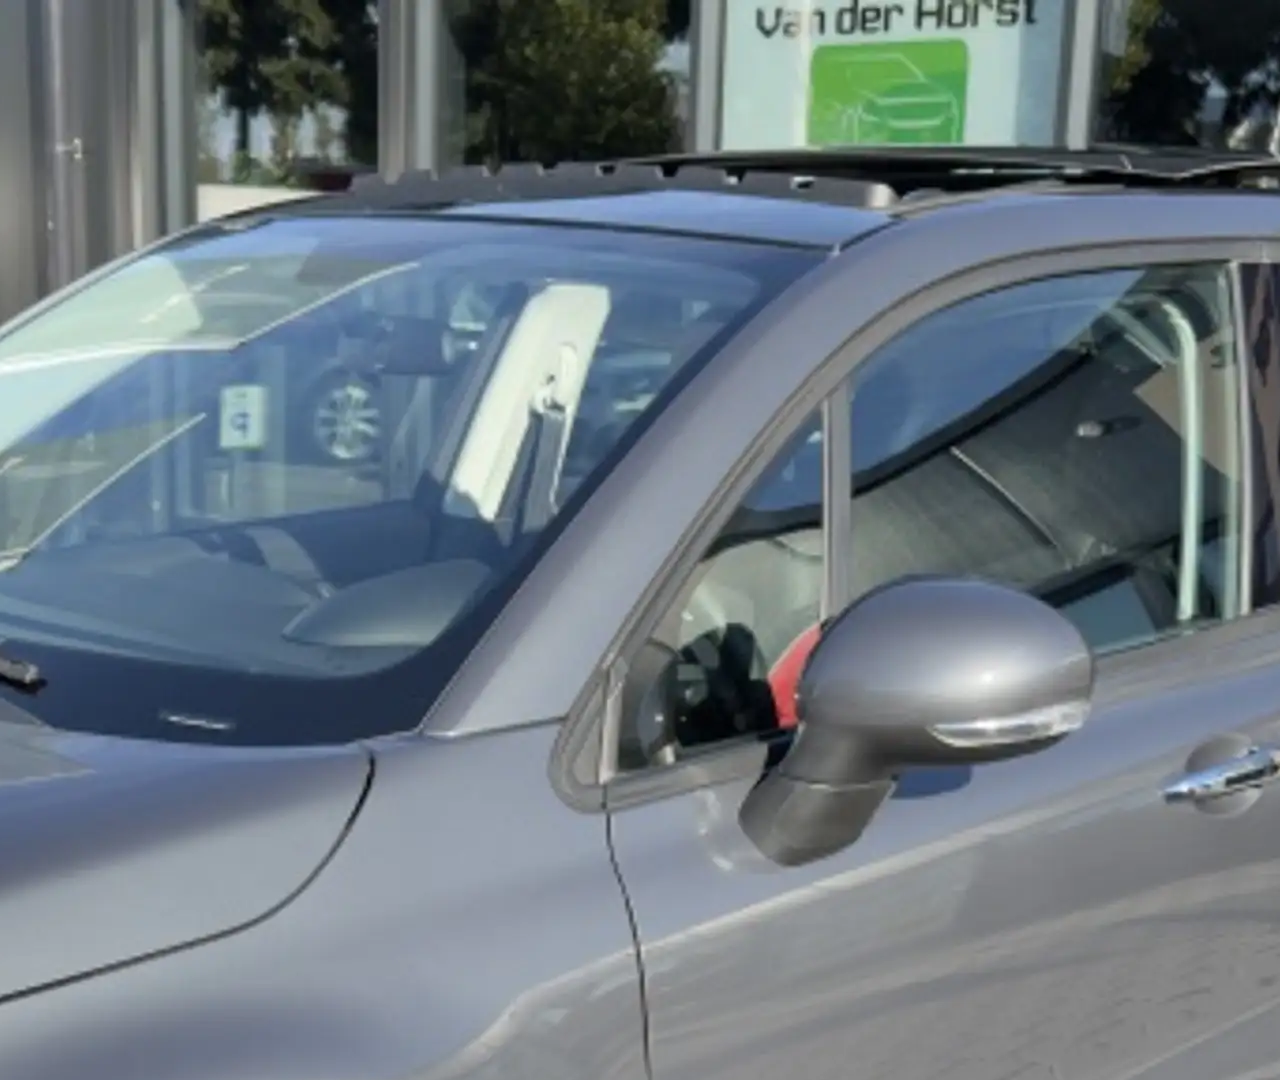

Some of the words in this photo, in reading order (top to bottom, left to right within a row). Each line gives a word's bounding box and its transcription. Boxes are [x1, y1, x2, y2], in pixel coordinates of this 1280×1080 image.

[756, 7, 825, 38] Van
[835, 0, 903, 35] der
[914, 0, 1037, 30] Horst
